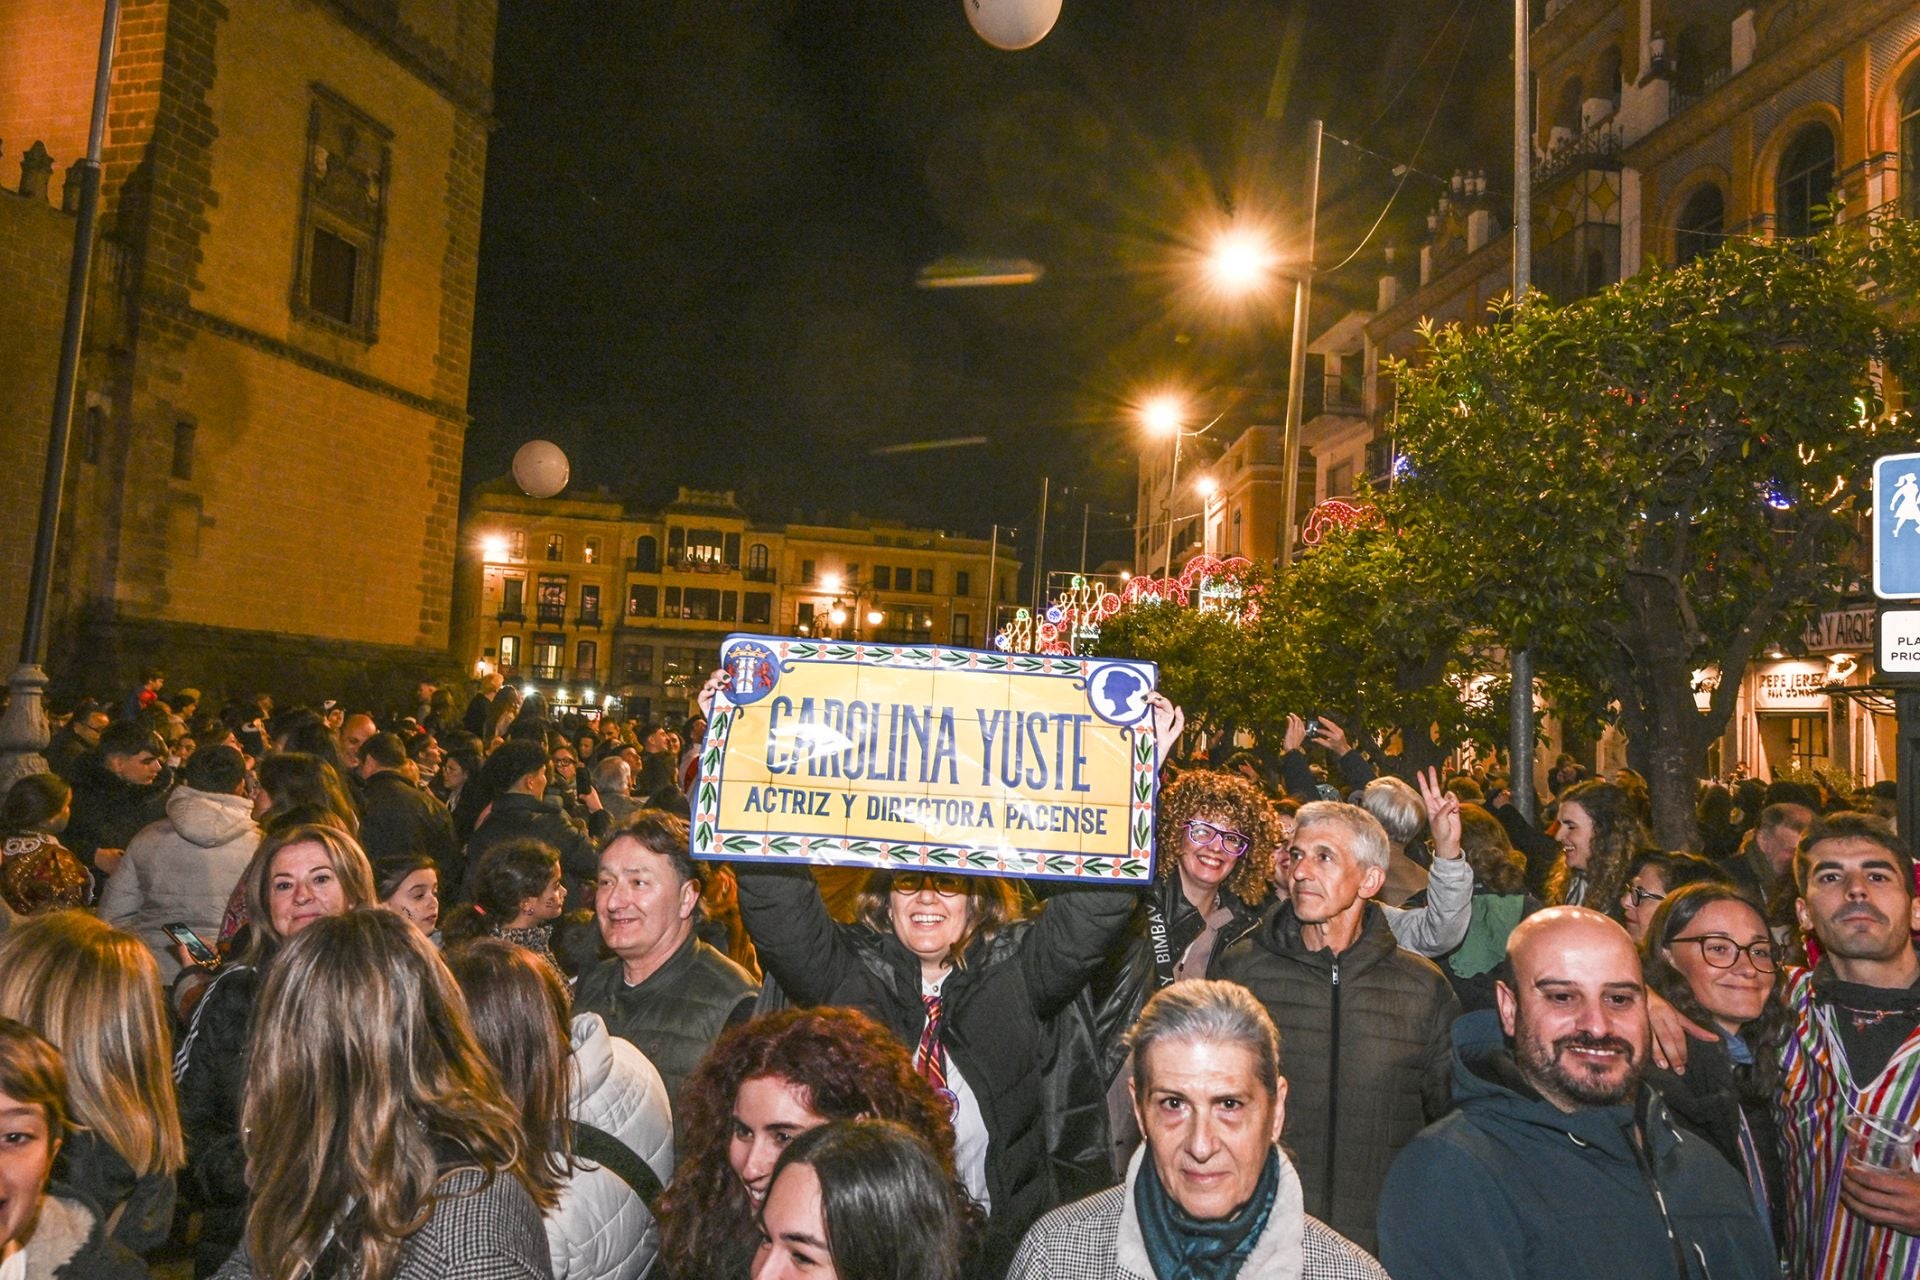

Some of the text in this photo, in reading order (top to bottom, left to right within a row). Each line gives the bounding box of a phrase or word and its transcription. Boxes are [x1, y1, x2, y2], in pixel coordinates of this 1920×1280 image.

[1759, 674, 1786, 688] PEPE
[766, 695, 1093, 793] CAROLINA YUSTE
[744, 785, 1108, 835] ACTRIZ Y DIRECTORA PACENSE
[1147, 913, 1171, 964] BIMBA
